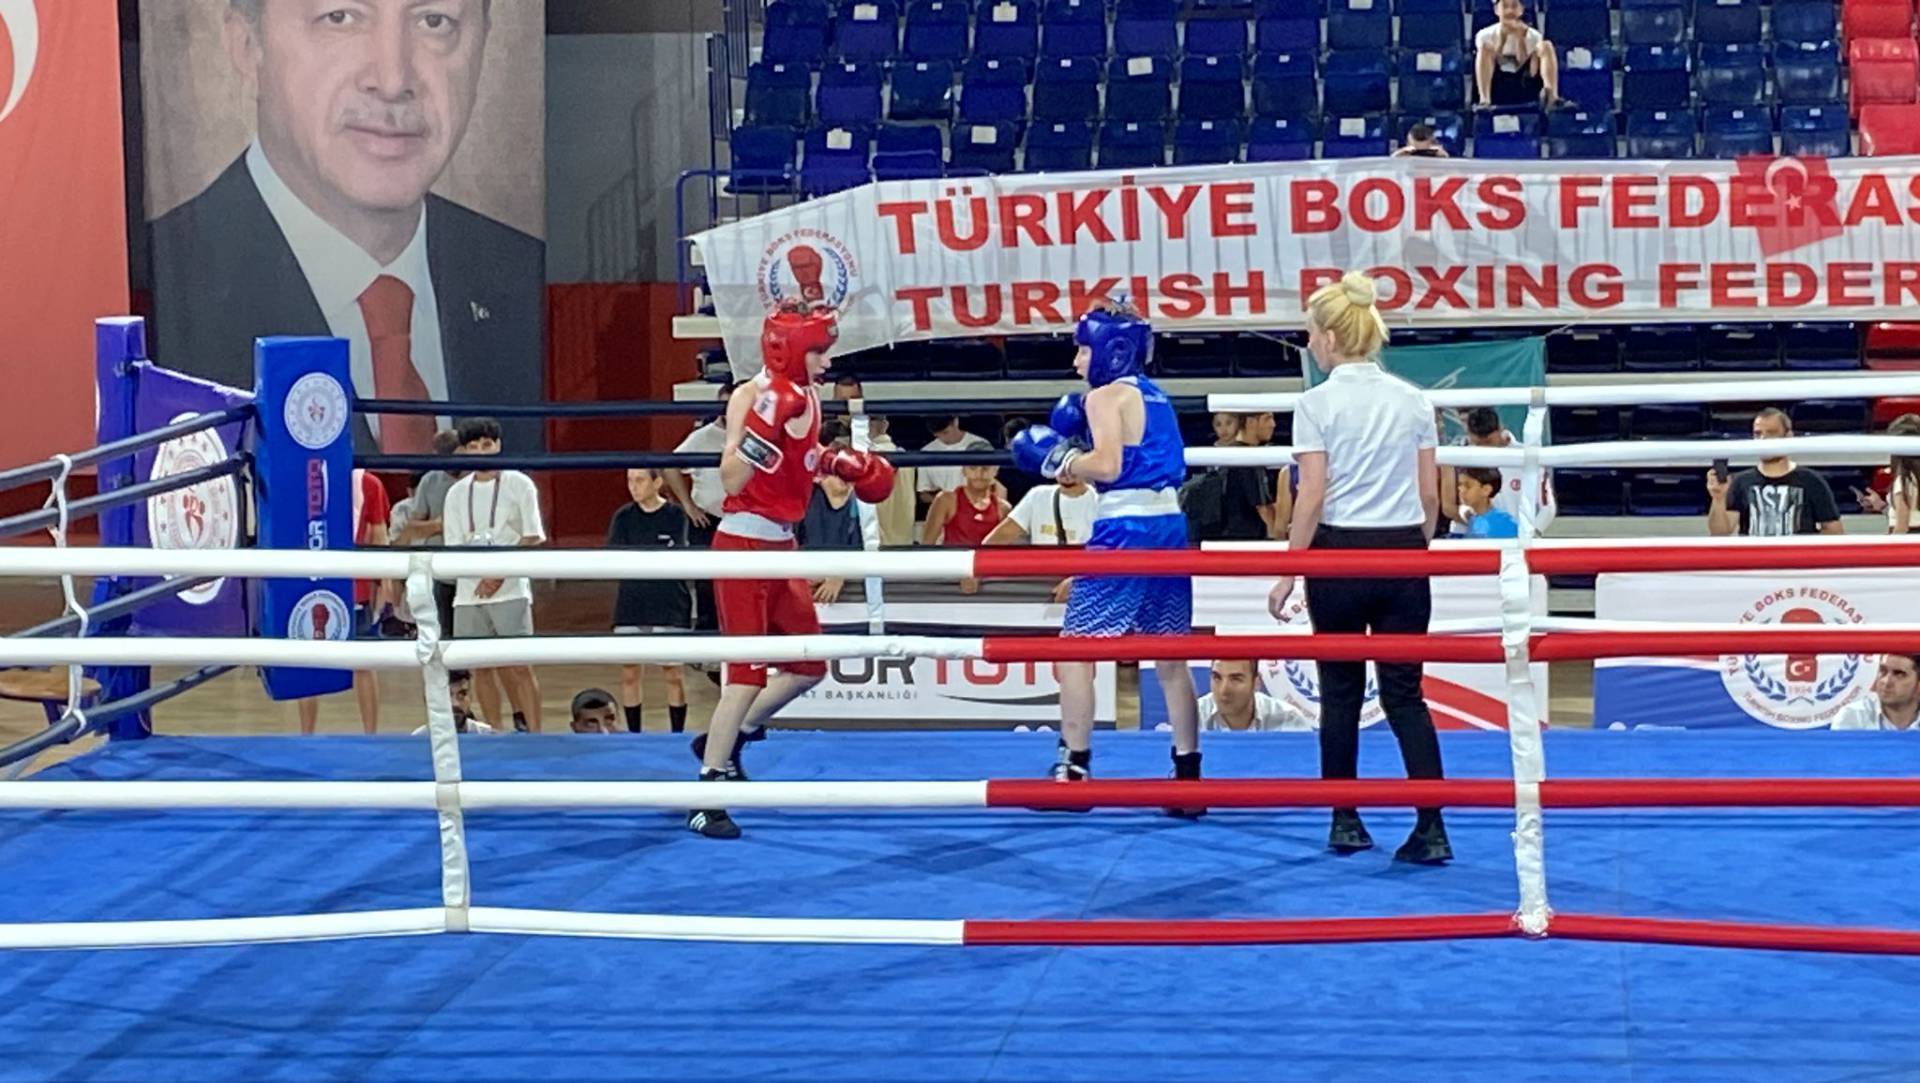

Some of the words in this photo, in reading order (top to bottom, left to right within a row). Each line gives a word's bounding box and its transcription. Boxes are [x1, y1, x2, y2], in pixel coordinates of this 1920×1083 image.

[878, 175, 1257, 254] TÜRKİYE
[1290, 176, 1526, 234] BOKS
[1559, 174, 1920, 228] FEDERA
[895, 270, 1266, 331] TURKISH
[1755, 587, 1795, 613] BOKS
